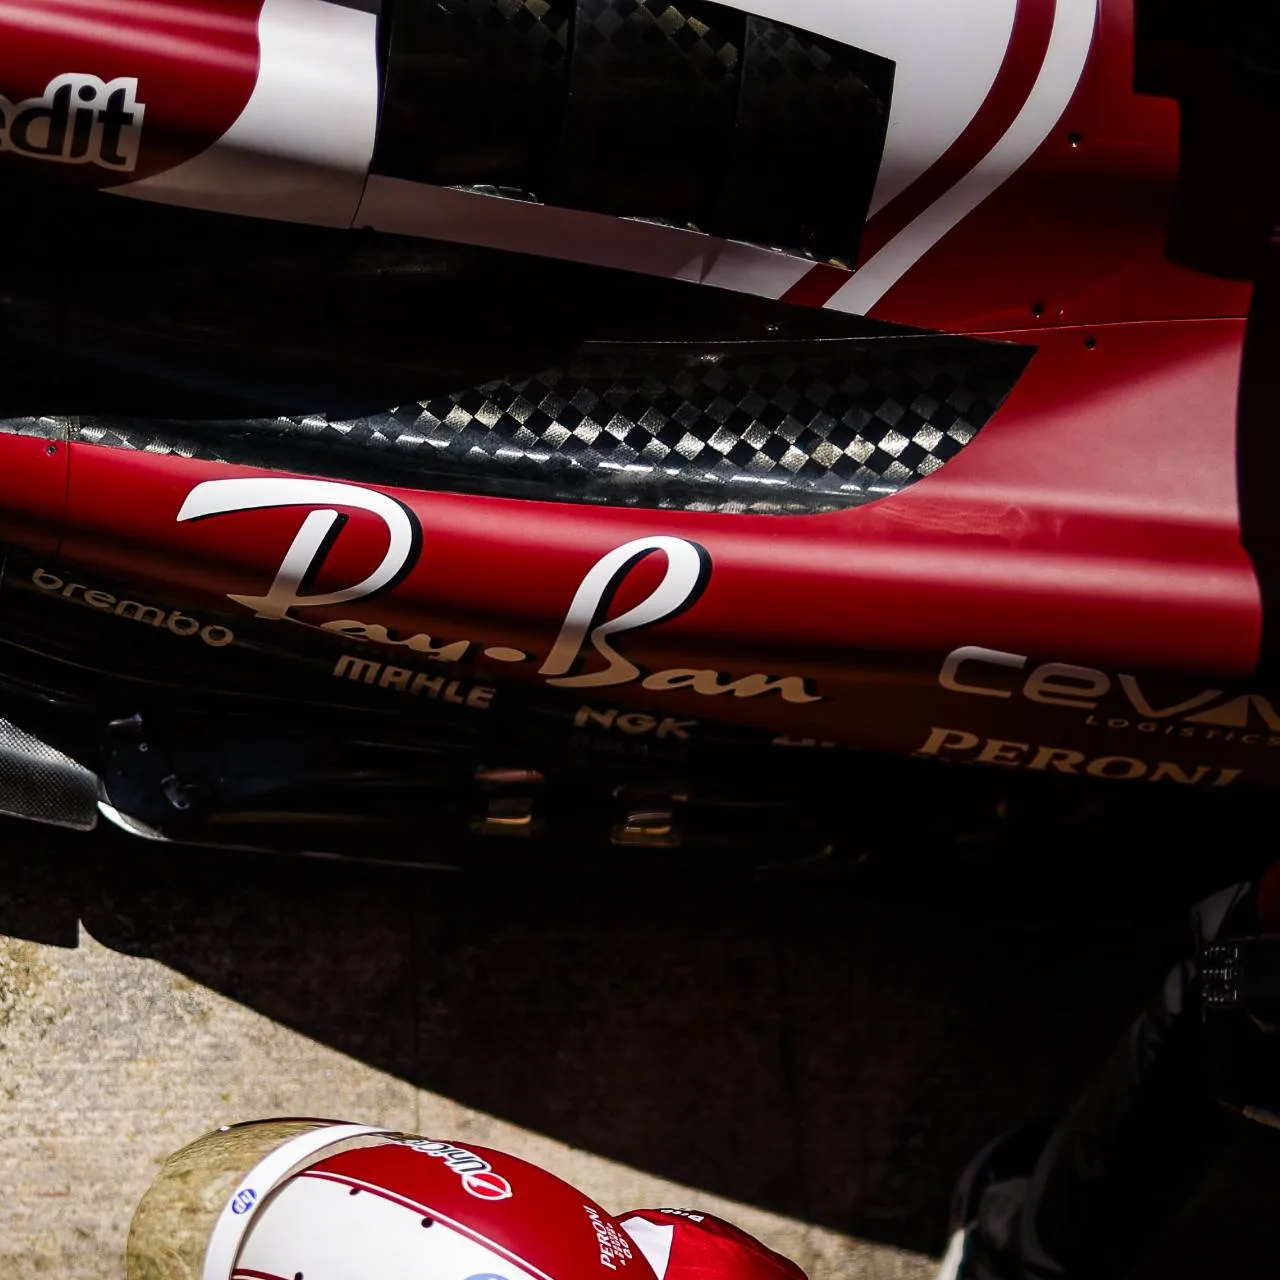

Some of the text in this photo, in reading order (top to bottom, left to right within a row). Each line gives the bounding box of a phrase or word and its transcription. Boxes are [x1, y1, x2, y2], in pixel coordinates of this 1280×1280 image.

[31, 567, 234, 648] brembo
[333, 653, 497, 710] MAHLE
[572, 705, 698, 740] NGK
[917, 727, 1243, 786] PERONI
[582, 1204, 617, 1271] PERONI
